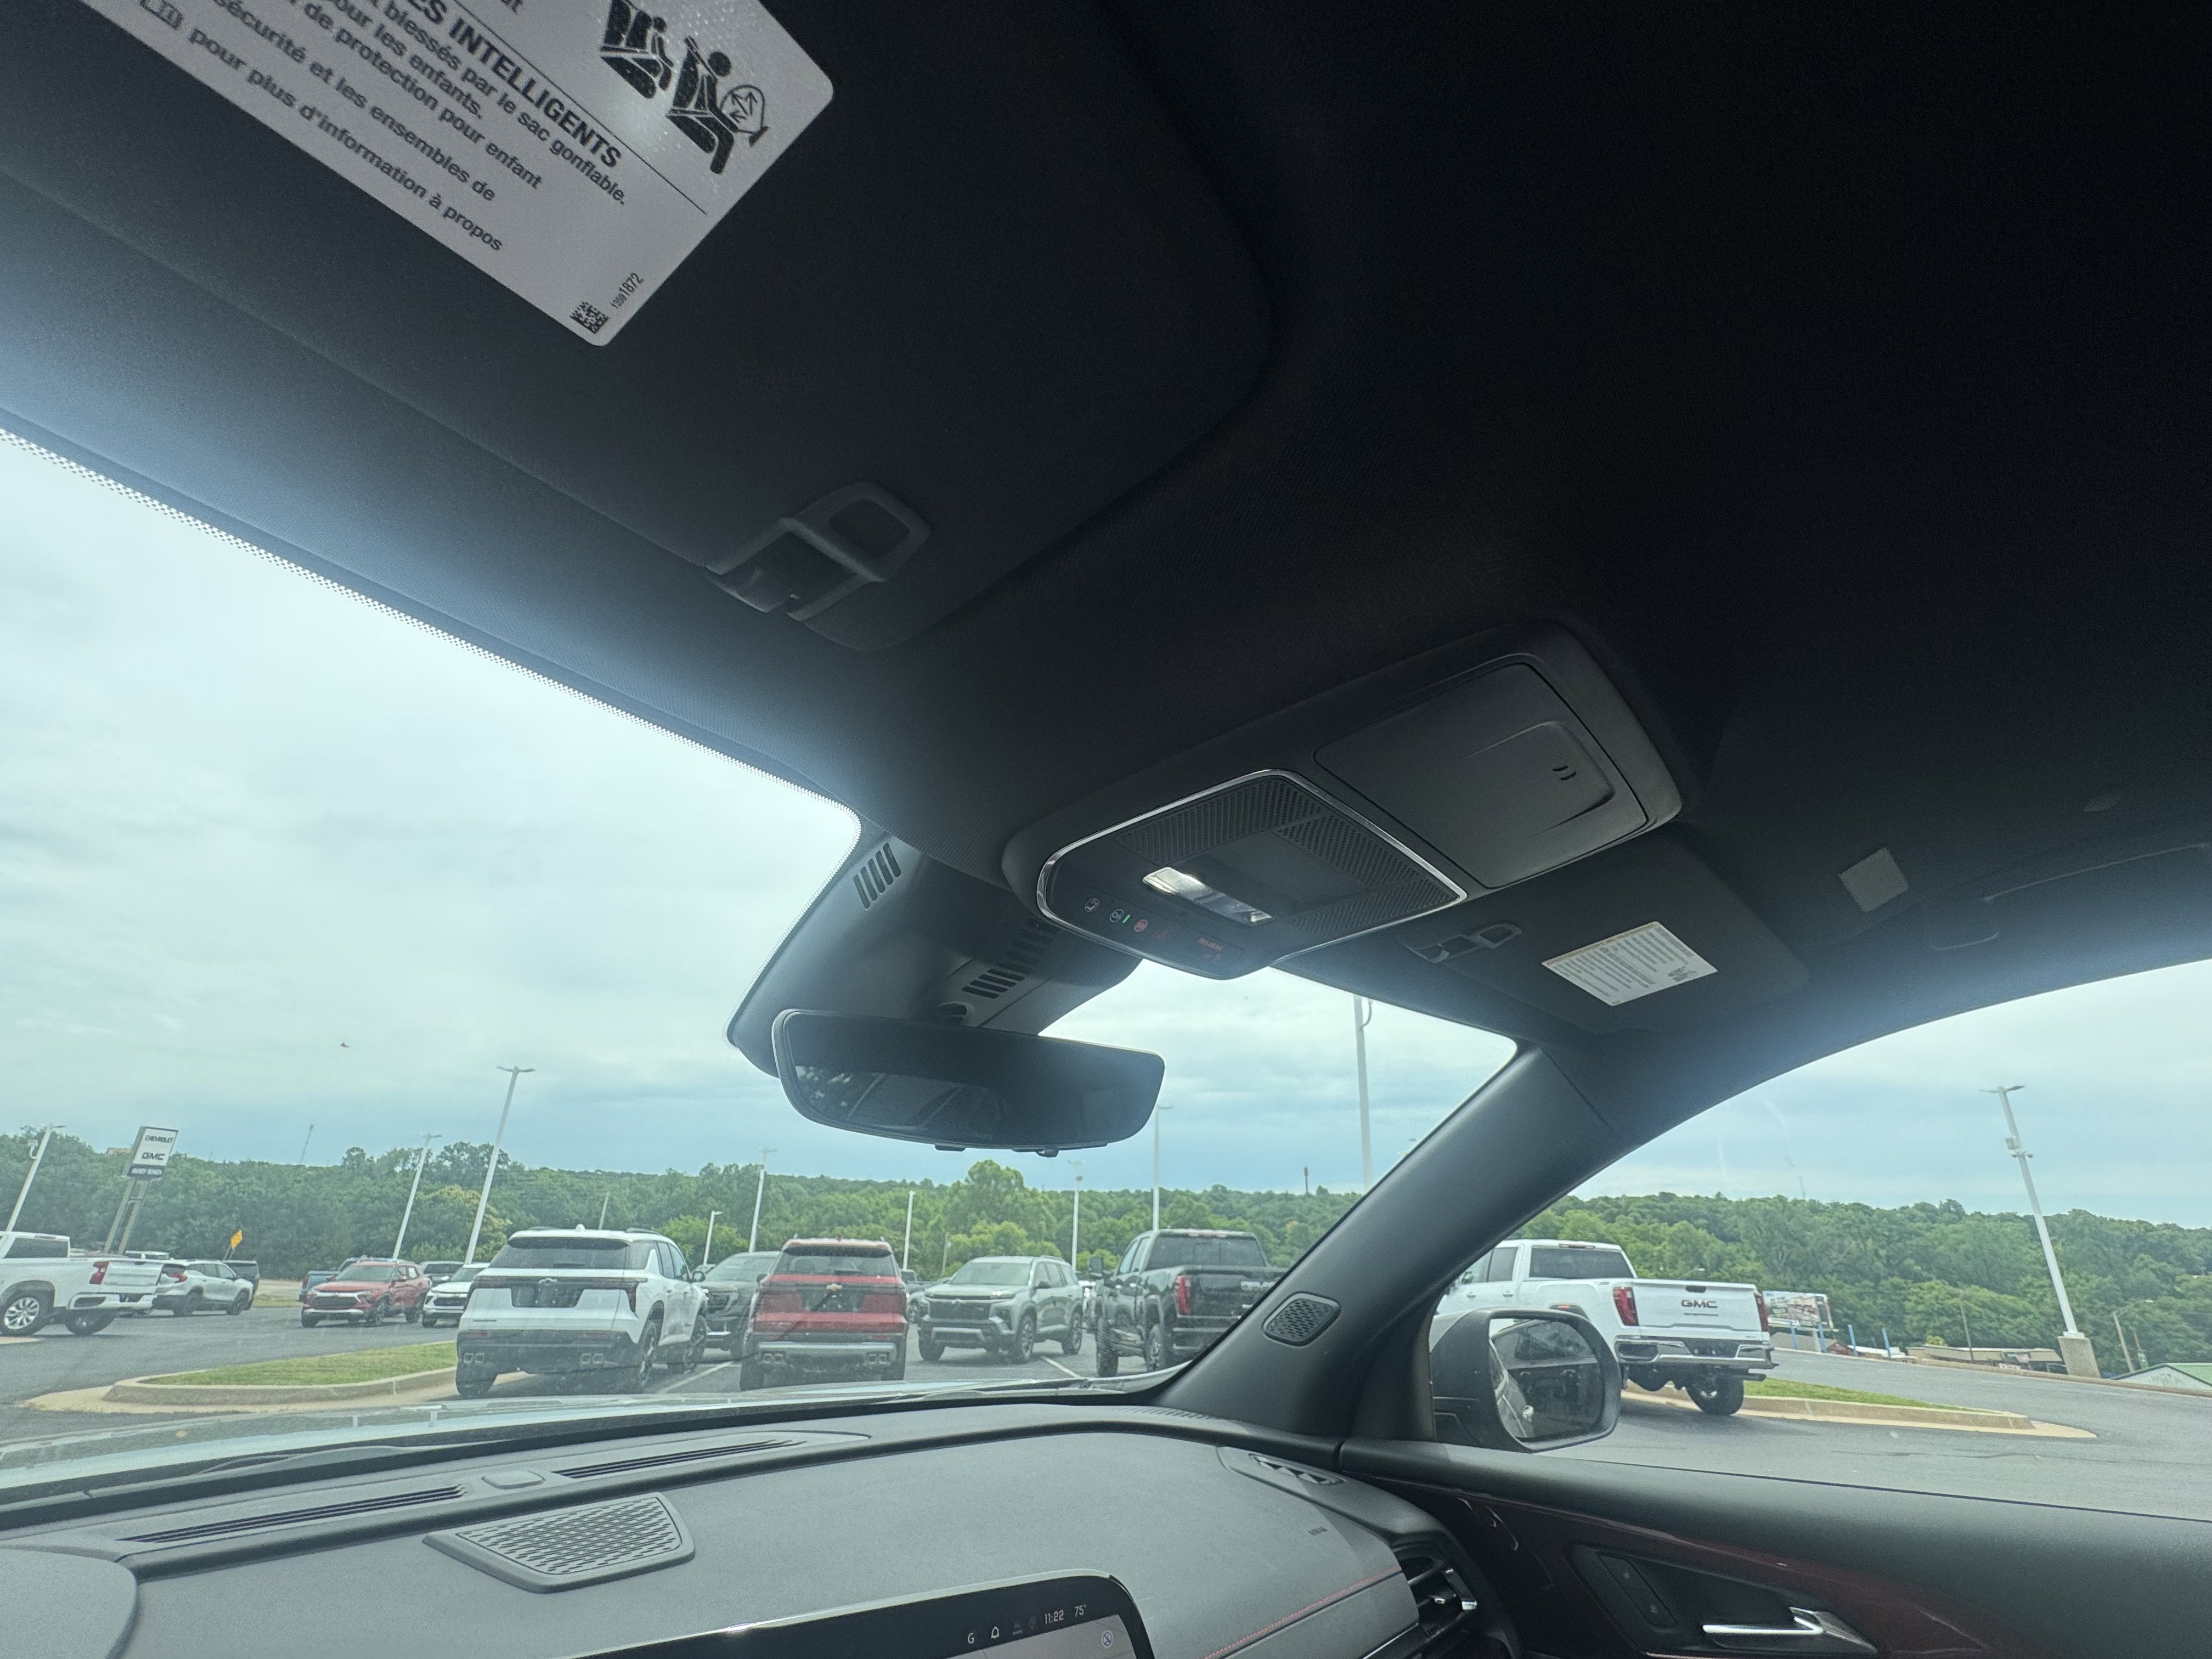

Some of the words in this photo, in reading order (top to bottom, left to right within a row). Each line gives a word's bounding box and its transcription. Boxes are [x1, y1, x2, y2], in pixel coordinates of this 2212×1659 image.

[188, 27, 246, 70] pour
[247, 69, 297, 109] plus
[298, 105, 427, 199] d'information
[428, 193, 442, 210] à
[442, 206, 503, 251] propos
[303, 2, 334, 30] de
[334, 29, 438, 111] protection
[439, 108, 487, 144] pour
[486, 143, 543, 190] enfant
[309, 61, 334, 83] et
[336, 77, 368, 108] les
[370, 106, 470, 183] ensembles
[471, 180, 496, 201] de
[374, 23, 407, 57] les
[409, 54, 482, 120] enfants.
[385, 1, 462, 71] blessés
[461, 67, 498, 97] par
[496, 92, 516, 114] le
[517, 111, 551, 142] sac
[549, 139, 625, 206] gonflable.
[448, 17, 622, 168] INTELLIGENTS
[142, 1152, 165, 1160] GMC
[1681, 1299, 1718, 1309] GMC
[1044, 1609, 1064, 1626] 11:22
